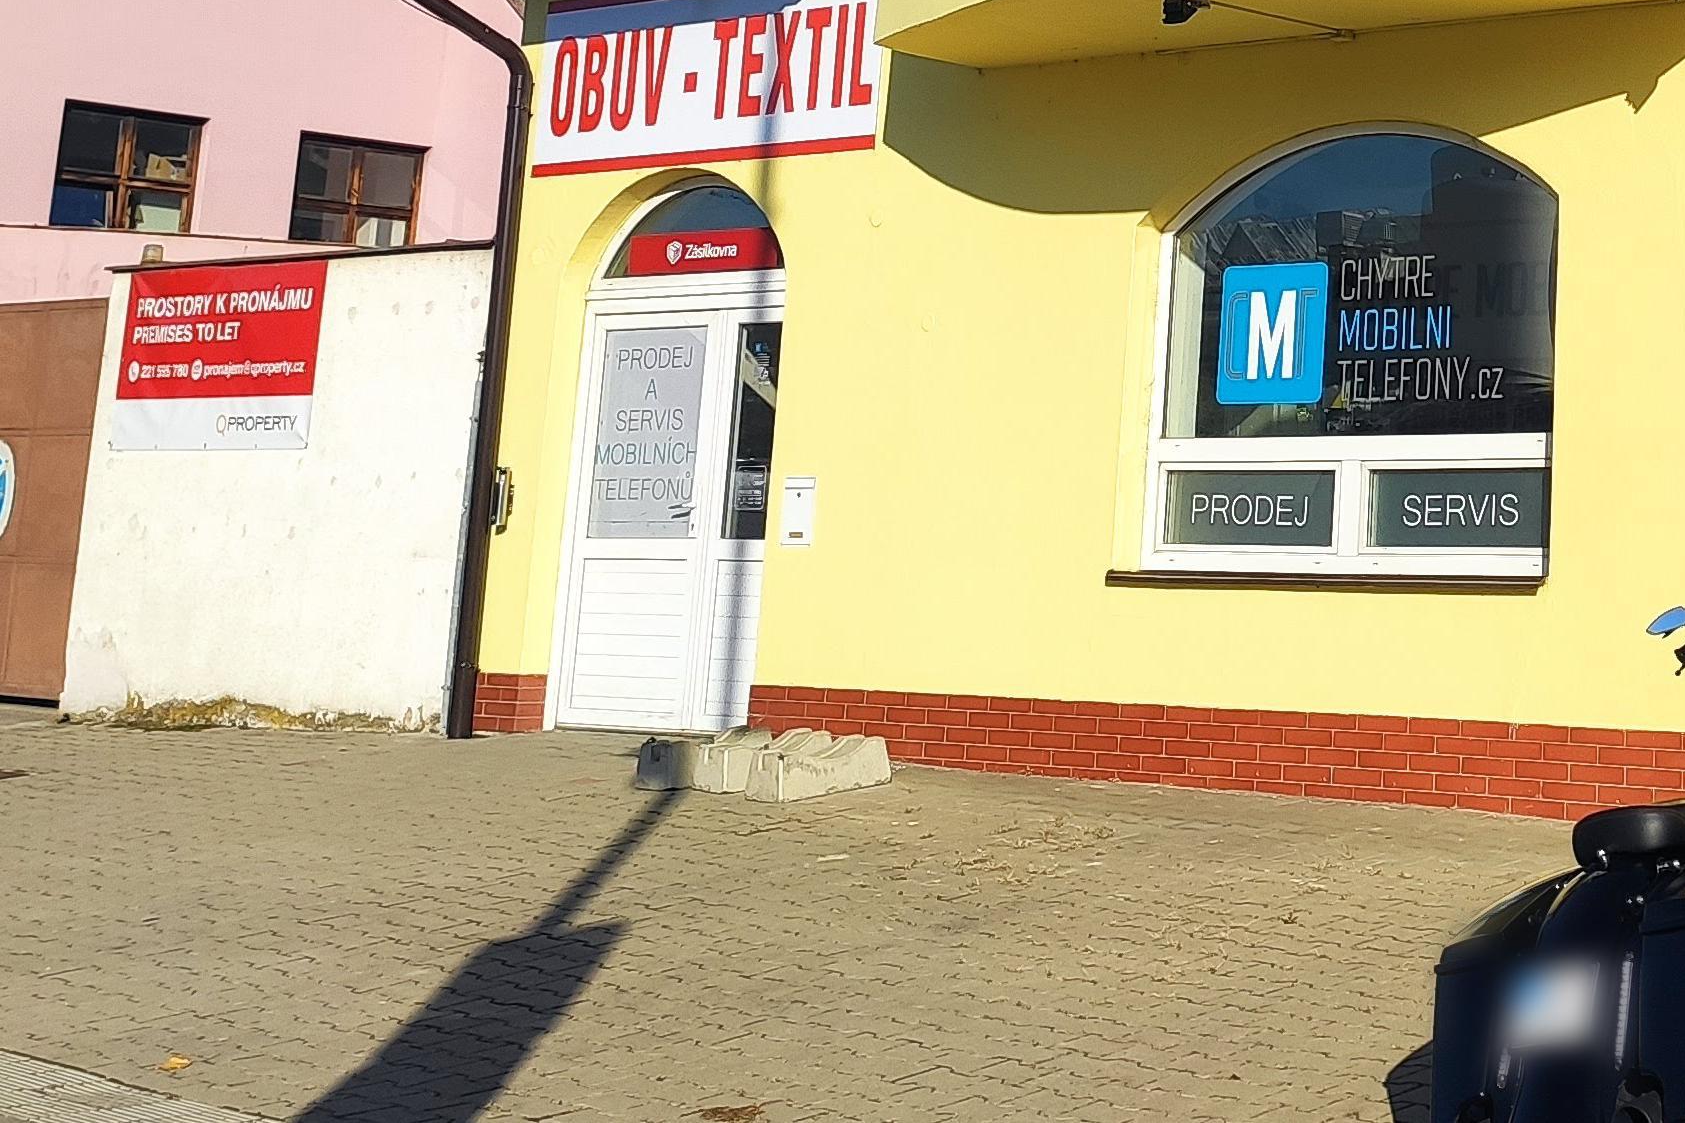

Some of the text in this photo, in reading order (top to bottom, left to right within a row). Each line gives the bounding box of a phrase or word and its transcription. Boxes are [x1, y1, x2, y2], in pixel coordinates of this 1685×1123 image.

[549, 25, 673, 137] OBUV
[714, 2, 872, 120] TEXTIL
[684, 242, 738, 260] Zásilkovna
[1340, 255, 1435, 301] CHYTRE
[136, 284, 313, 318] PROSTORY K PRONÁJMU
[133, 322, 241, 344] PREMISES TO LET
[1338, 305, 1452, 352] MOBILNI
[617, 346, 693, 370] PRODEJ
[644, 378, 657, 400] A
[615, 408, 684, 433] SERVIS
[595, 435, 697, 465] MOBILNÍCH
[595, 471, 694, 501] TELEFONŮ
[1190, 494, 1309, 527] PRODEJ
[1402, 493, 1520, 527] SERVIS
